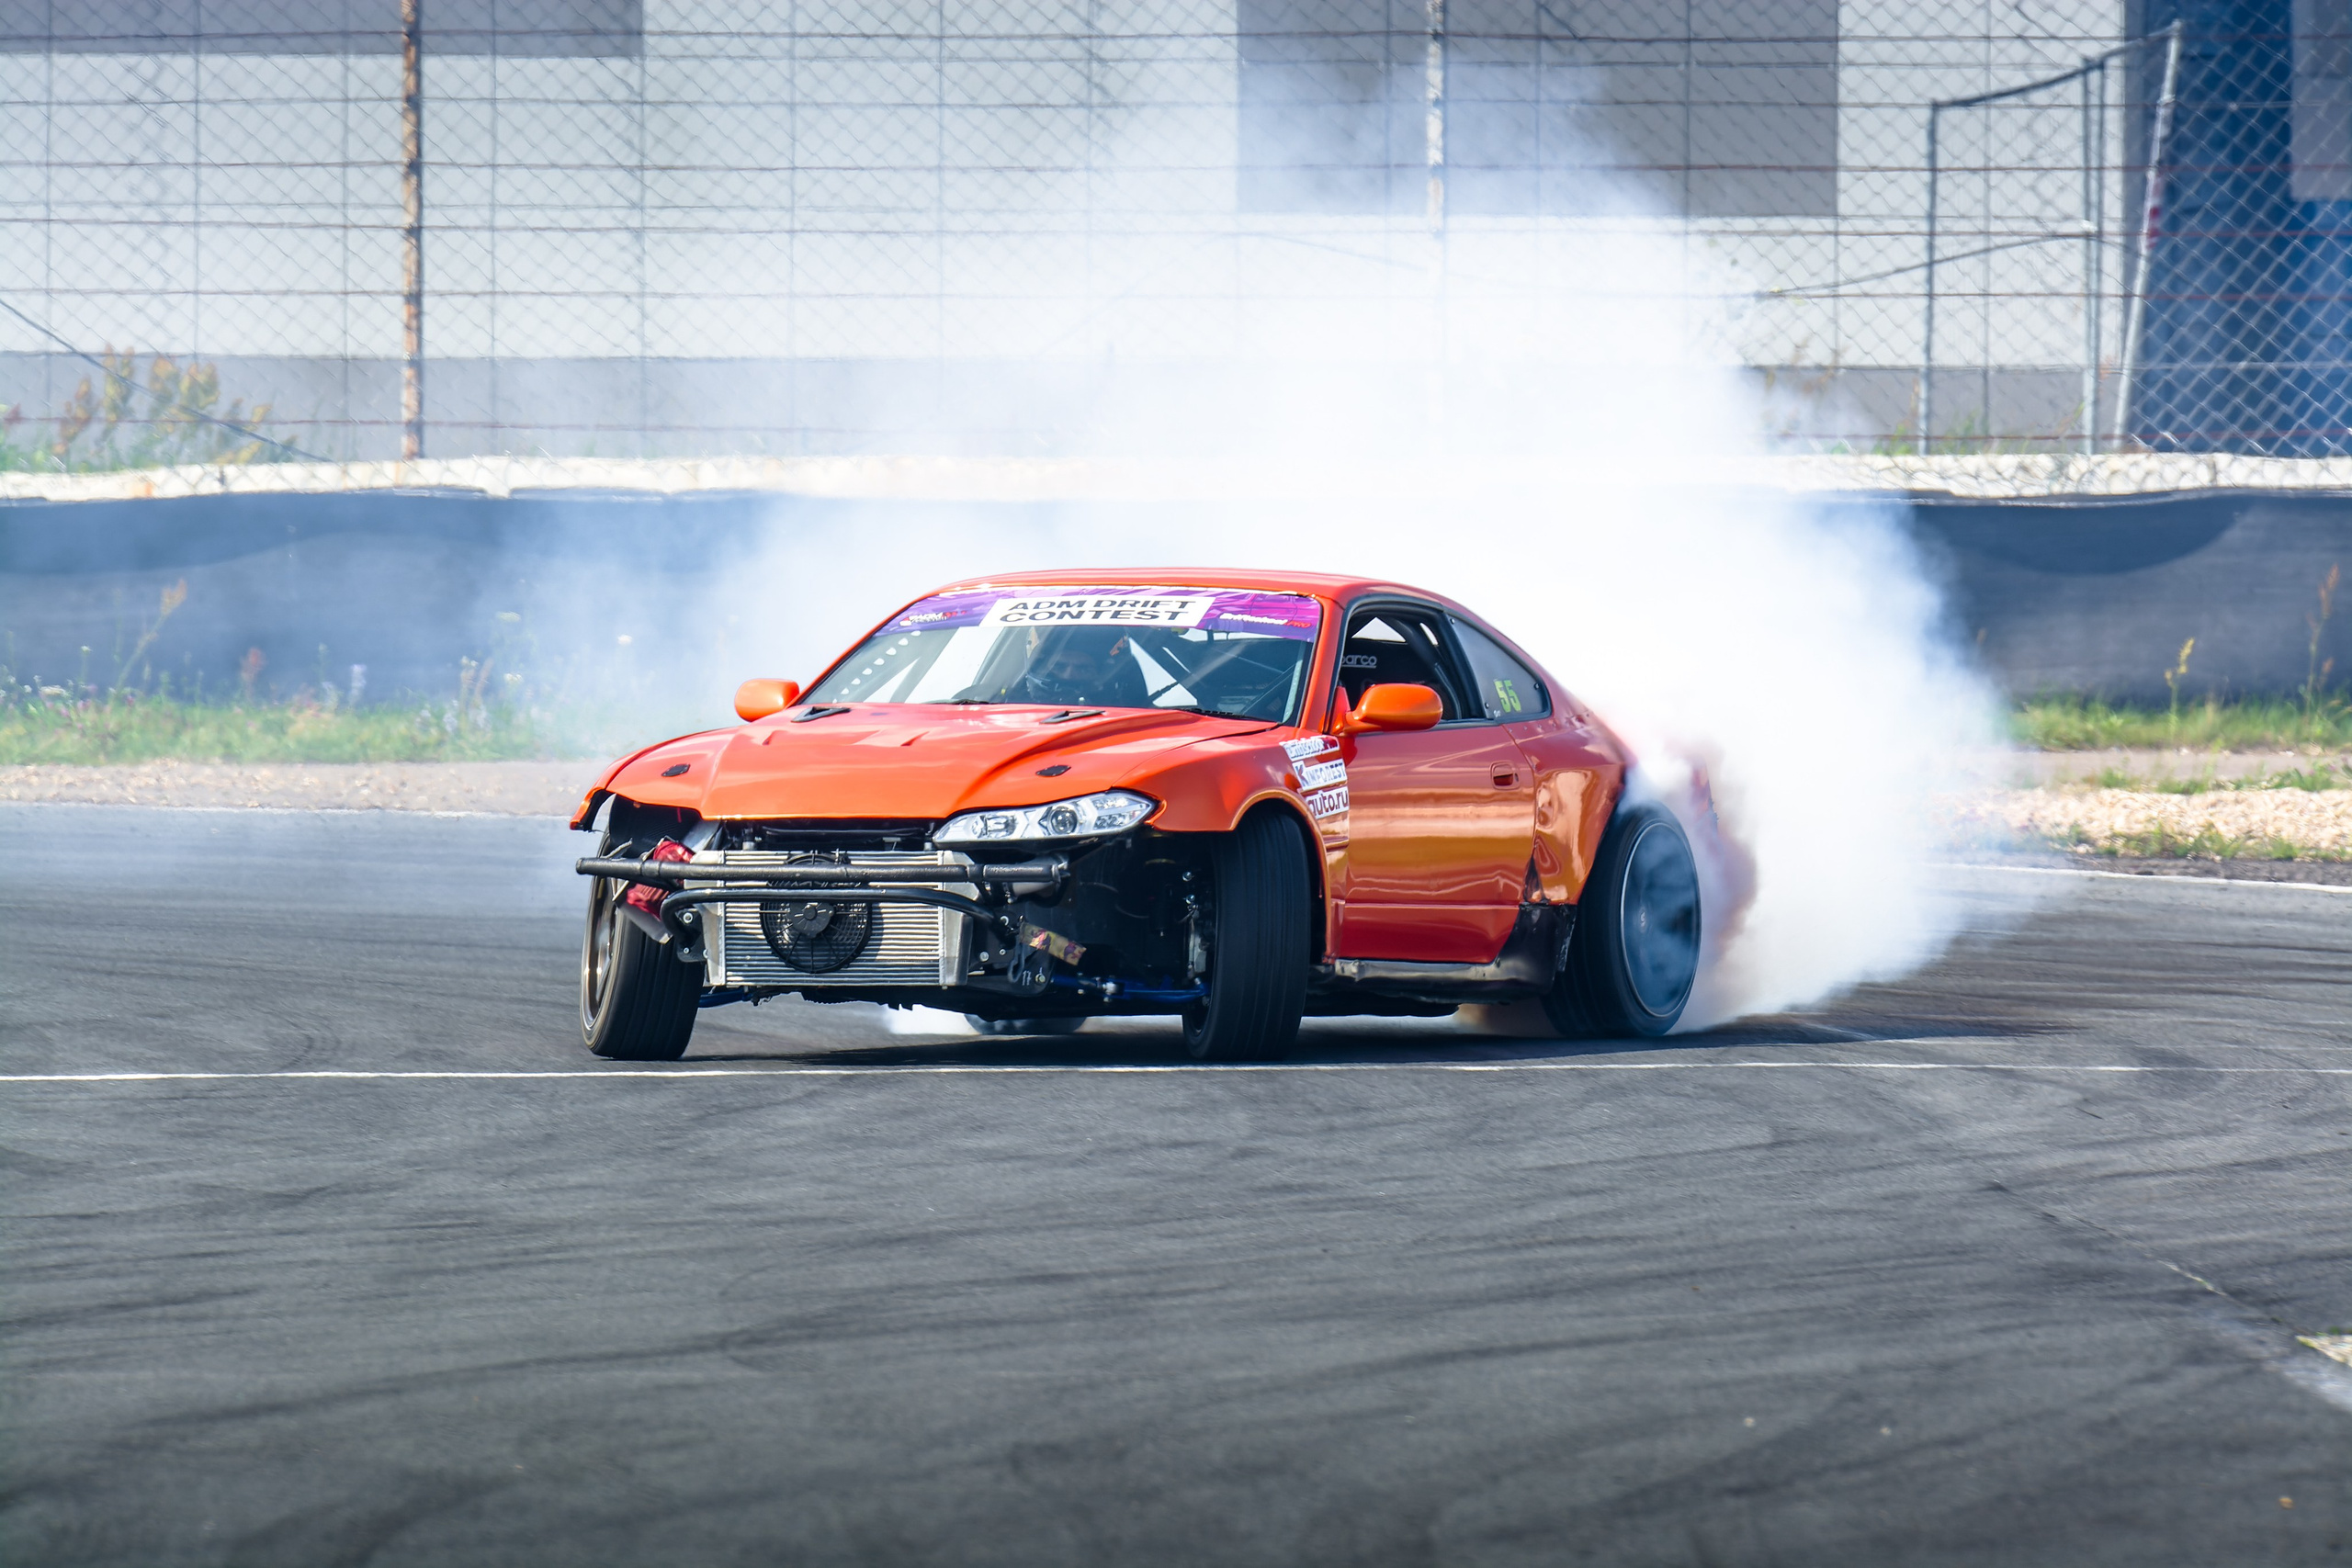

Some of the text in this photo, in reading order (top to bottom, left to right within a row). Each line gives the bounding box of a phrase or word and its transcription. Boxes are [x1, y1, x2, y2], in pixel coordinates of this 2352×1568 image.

[1009, 600, 1196, 611] ADM DRIFT
[1000, 609, 1189, 623] CONTEST
[1494, 680, 1521, 713] 55
[1307, 791, 1349, 816] auto.ru
